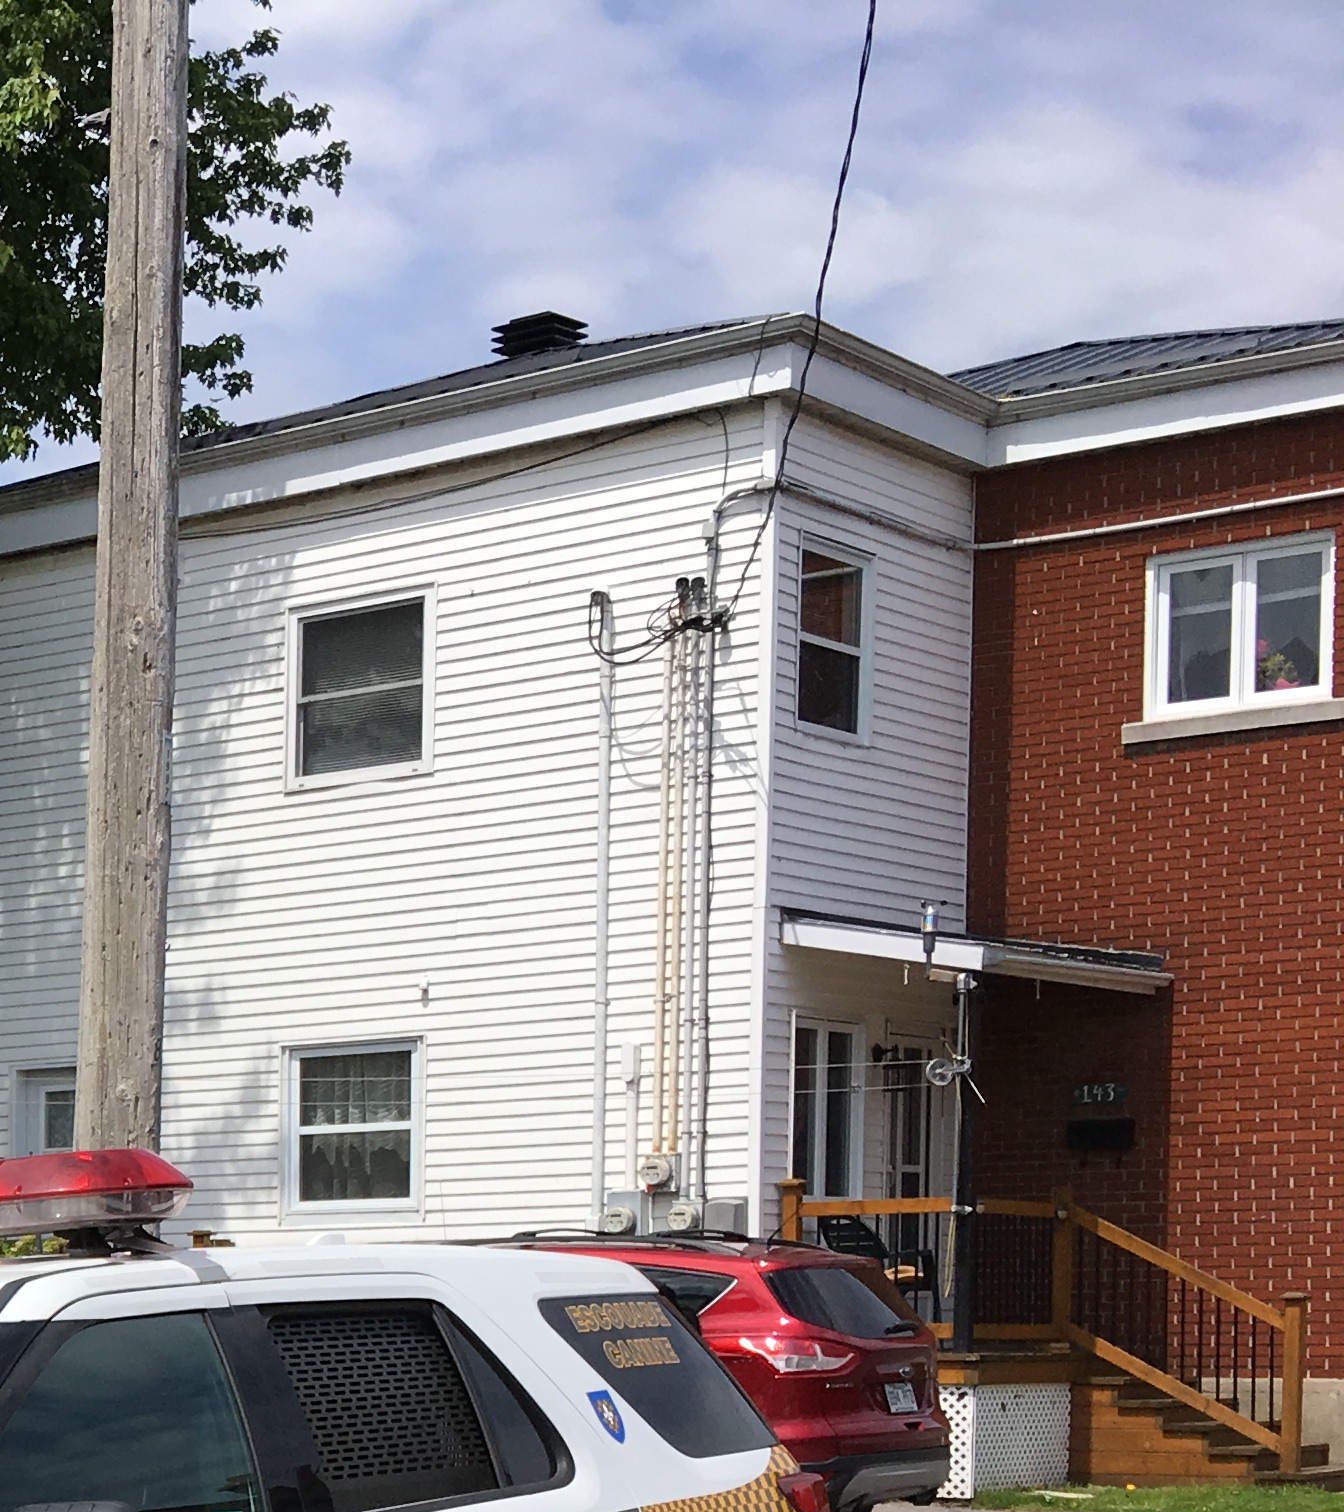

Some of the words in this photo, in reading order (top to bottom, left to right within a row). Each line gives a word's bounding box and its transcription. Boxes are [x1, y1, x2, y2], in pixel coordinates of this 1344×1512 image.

[1082, 1083, 1115, 1102] 143
[564, 1301, 672, 1333] ESCOUADE
[602, 1336, 681, 1369] CANINE
